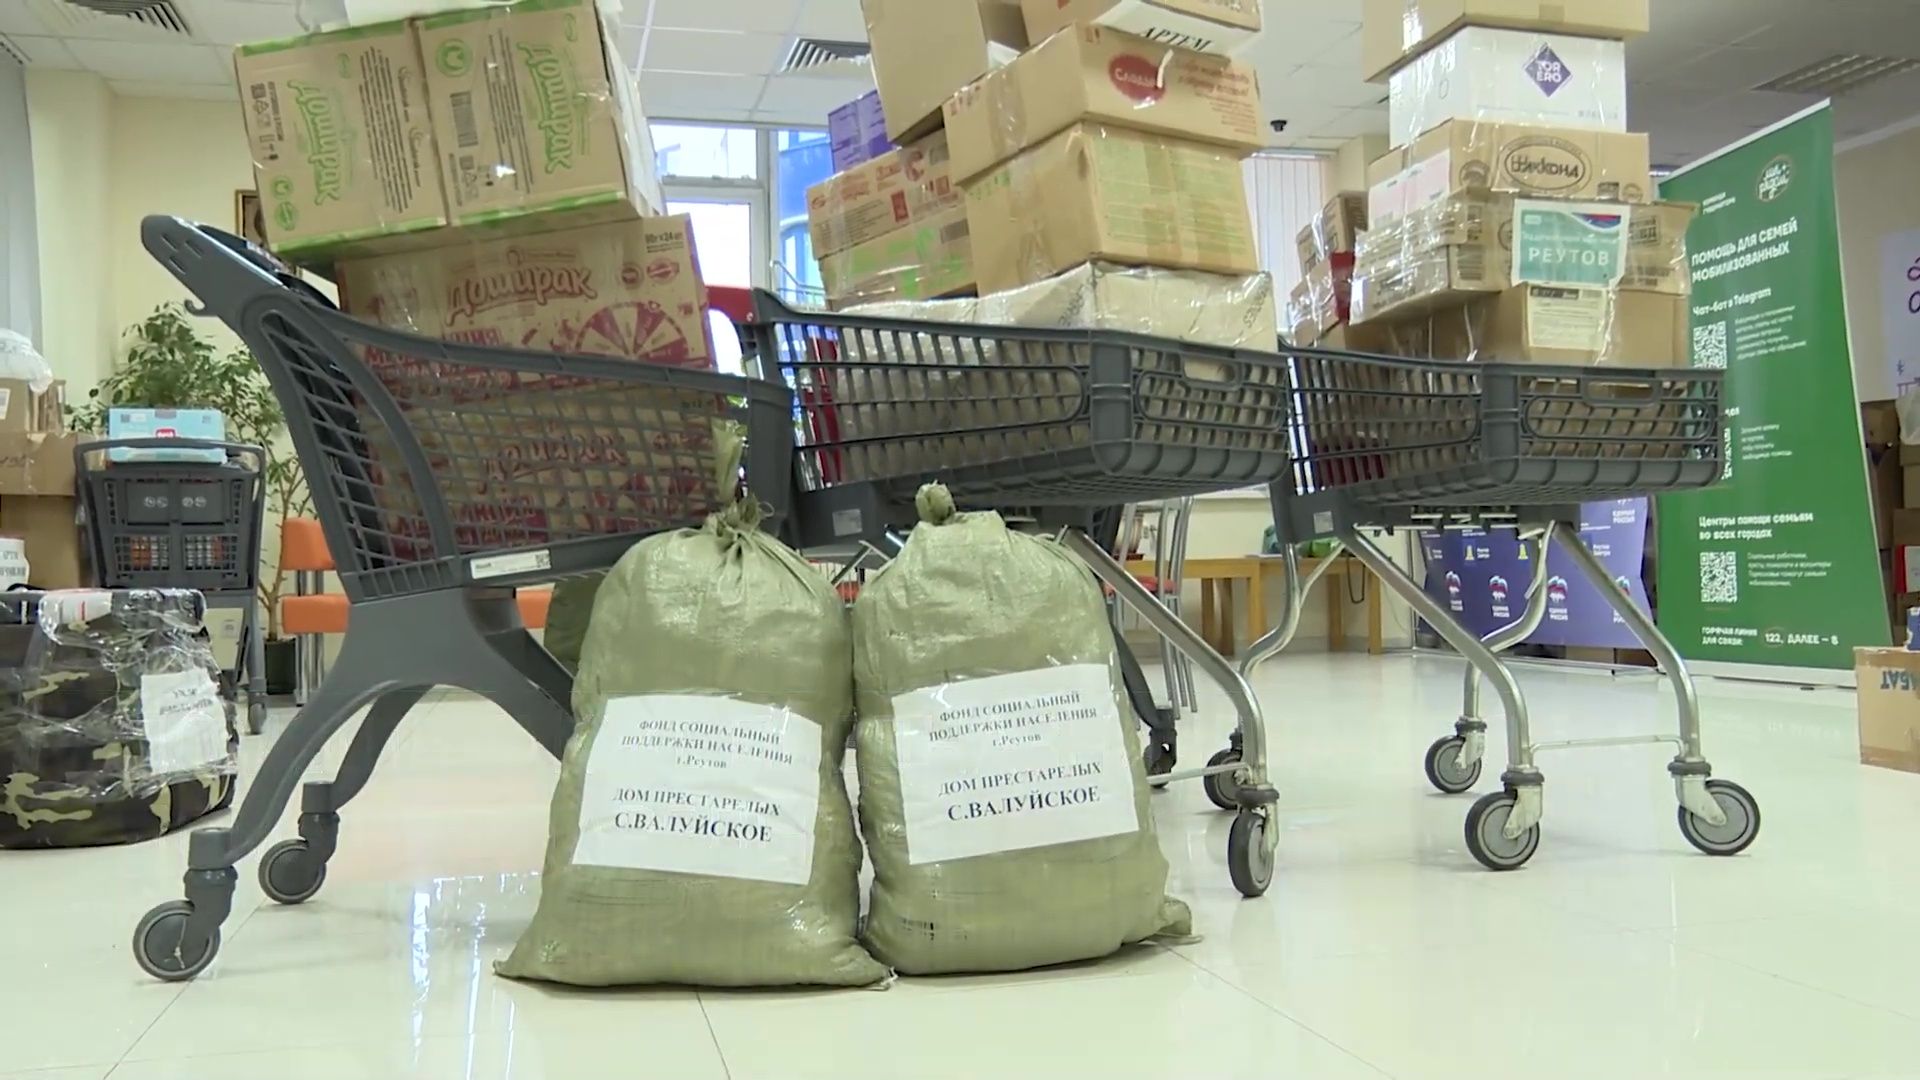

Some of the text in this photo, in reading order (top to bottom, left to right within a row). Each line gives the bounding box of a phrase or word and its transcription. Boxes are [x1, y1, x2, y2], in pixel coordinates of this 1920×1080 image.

[1528, 246, 1611, 266] РЕУТОВ
[1691, 216, 1799, 267] ПОМОЩЬ ДЛЯ СЕМЕЙ
[1692, 241, 1790, 283] МОБИЛИЗОВАННЫХ
[939, 690, 1081, 723] ФОНД СОЦИАЛЬНЫЙ
[639, 720, 781, 746] ФОНД СОЦИАЛЬНЫЙ
[929, 708, 1098, 742] ПОДДЕРЖКИ НАСЕЛЕНИЯ
[621, 735, 793, 765] ПОДДЕРЖКИ НАСЕЛЕНИЯ
[938, 761, 1102, 798] ДОМ ПРЕСТАРЕЛЫХ
[613, 788, 782, 817] ДОМ ПРЕСТАРЕЛЫХ
[947, 785, 1101, 822] С.ВАЛУЙСКОЕ
[614, 811, 773, 843] С.ВАЛУЙСКОЕ
